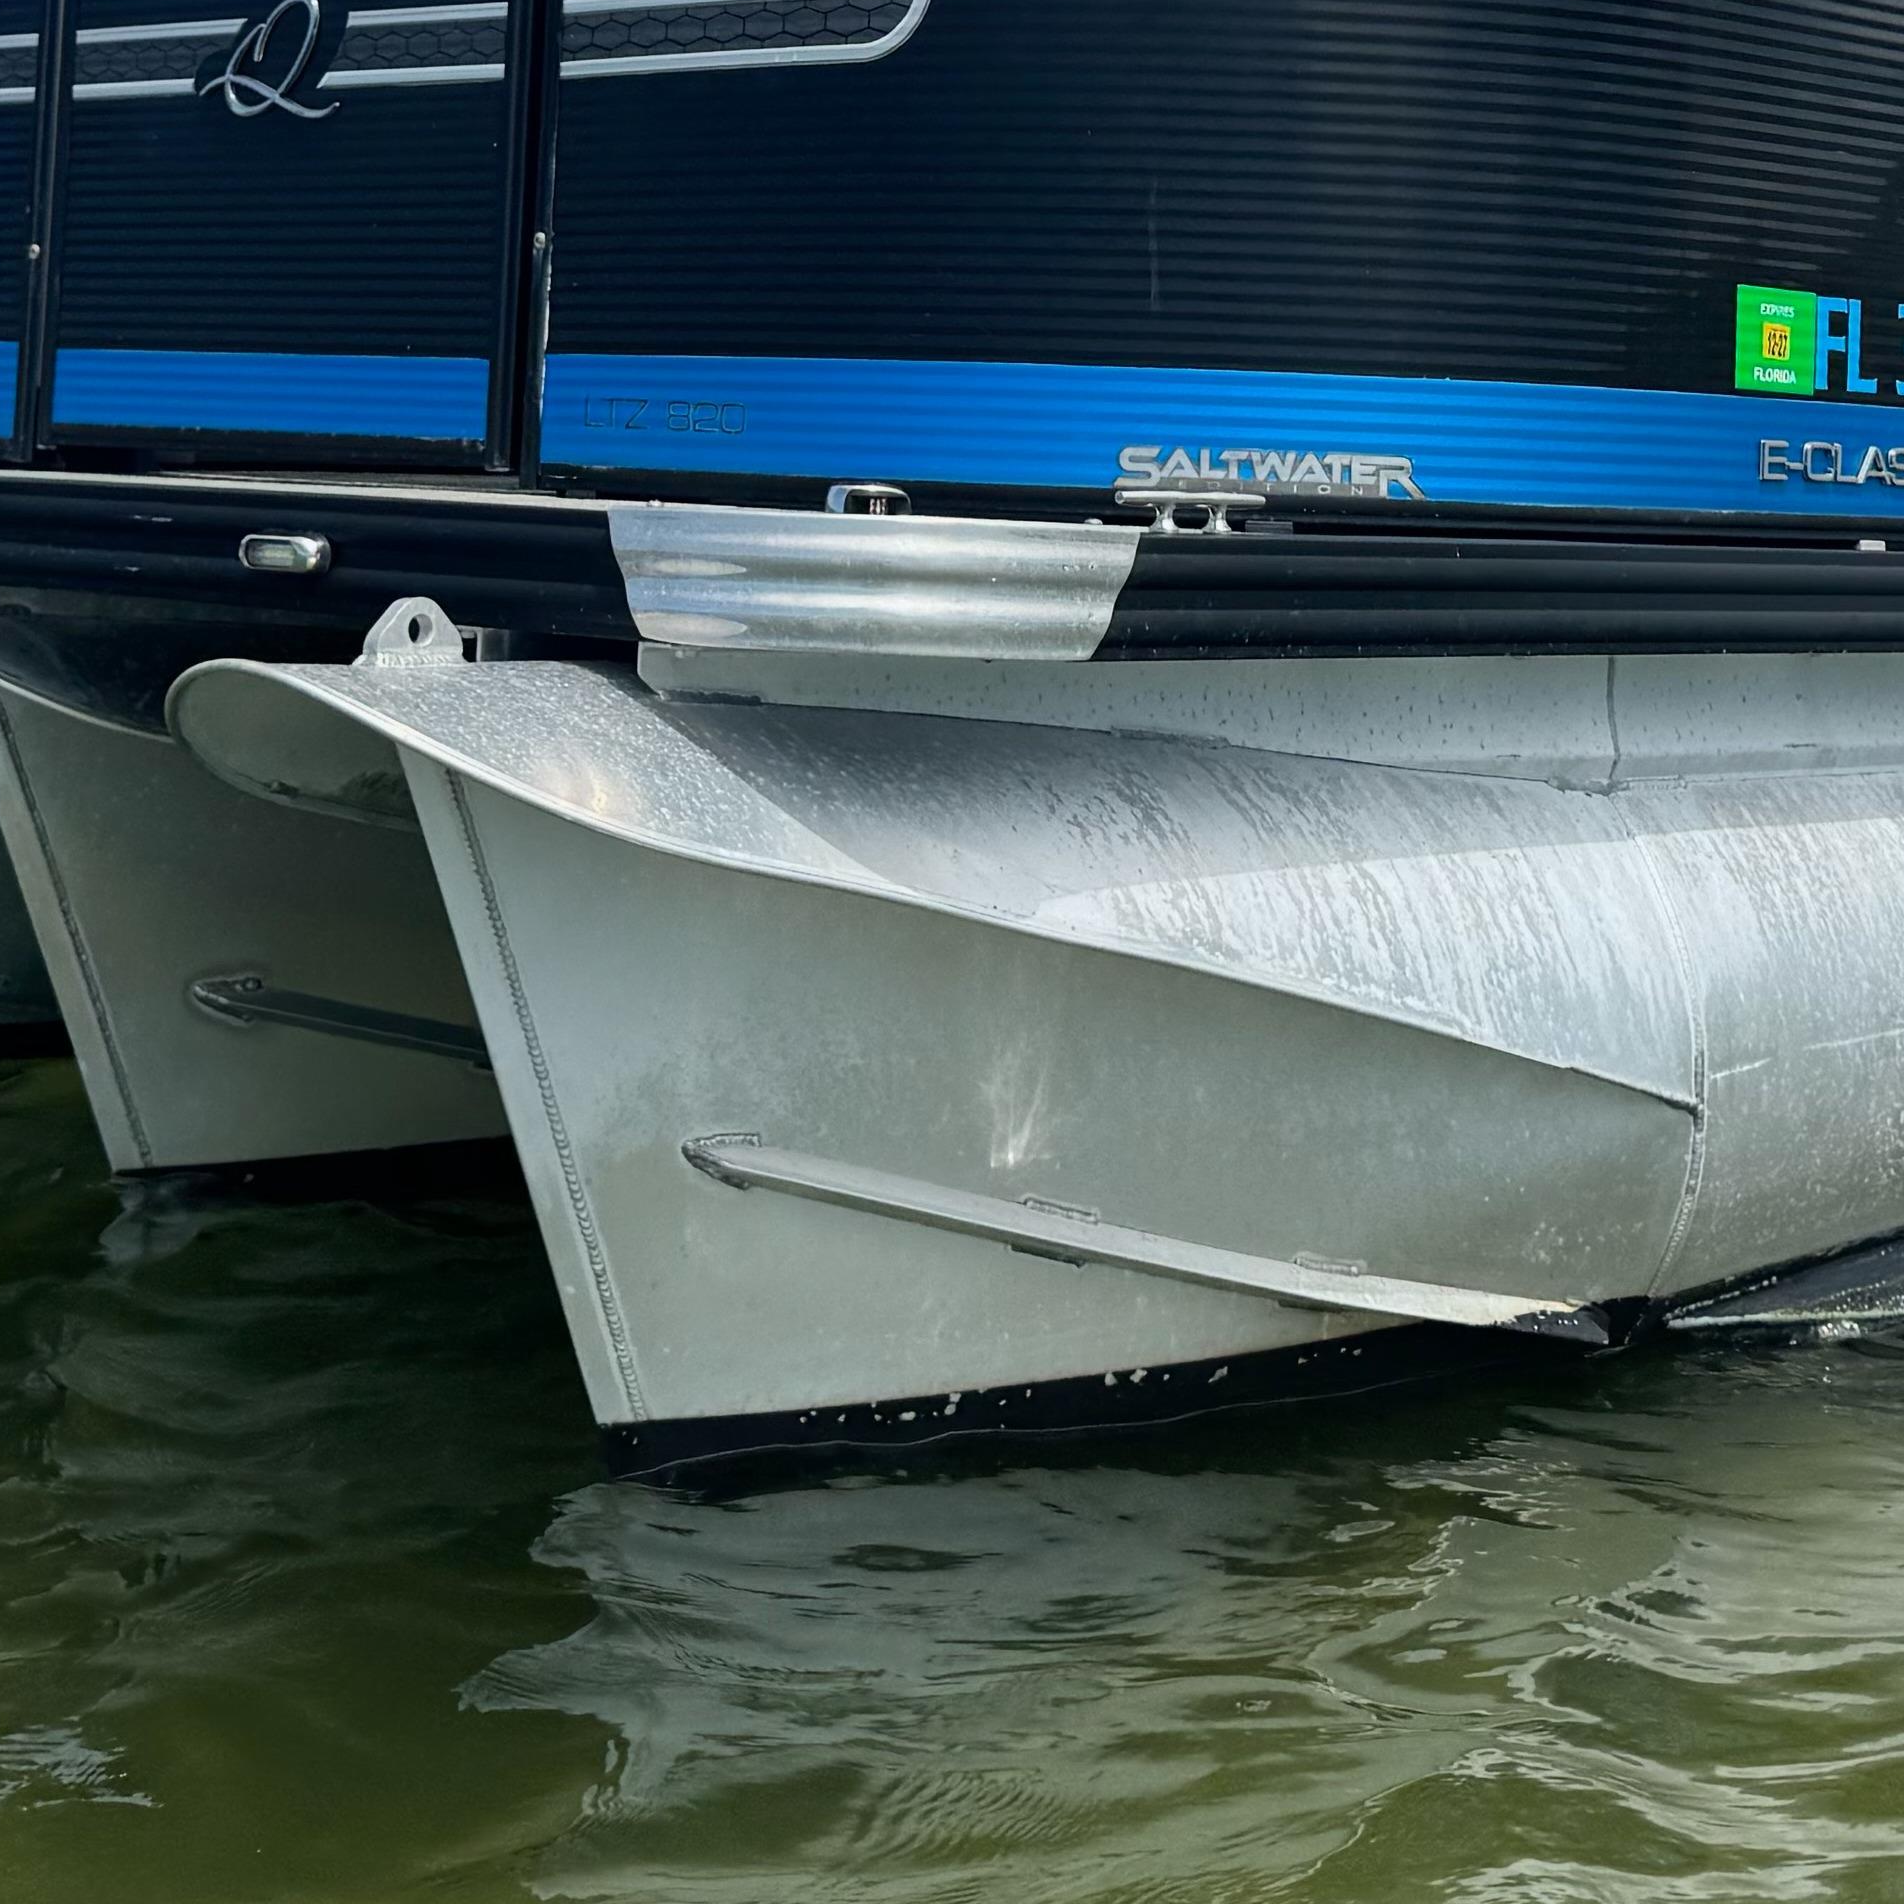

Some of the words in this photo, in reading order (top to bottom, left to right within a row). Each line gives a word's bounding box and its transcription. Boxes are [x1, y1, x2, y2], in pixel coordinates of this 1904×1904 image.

[1759, 302, 1796, 320] EXPIRES
[1814, 295, 1879, 394] FL
[1753, 366, 1797, 385] FLORIDA
[584, 395, 649, 430] LTZ
[666, 400, 746, 434] 820
[1113, 445, 1426, 499] SALTWATER
